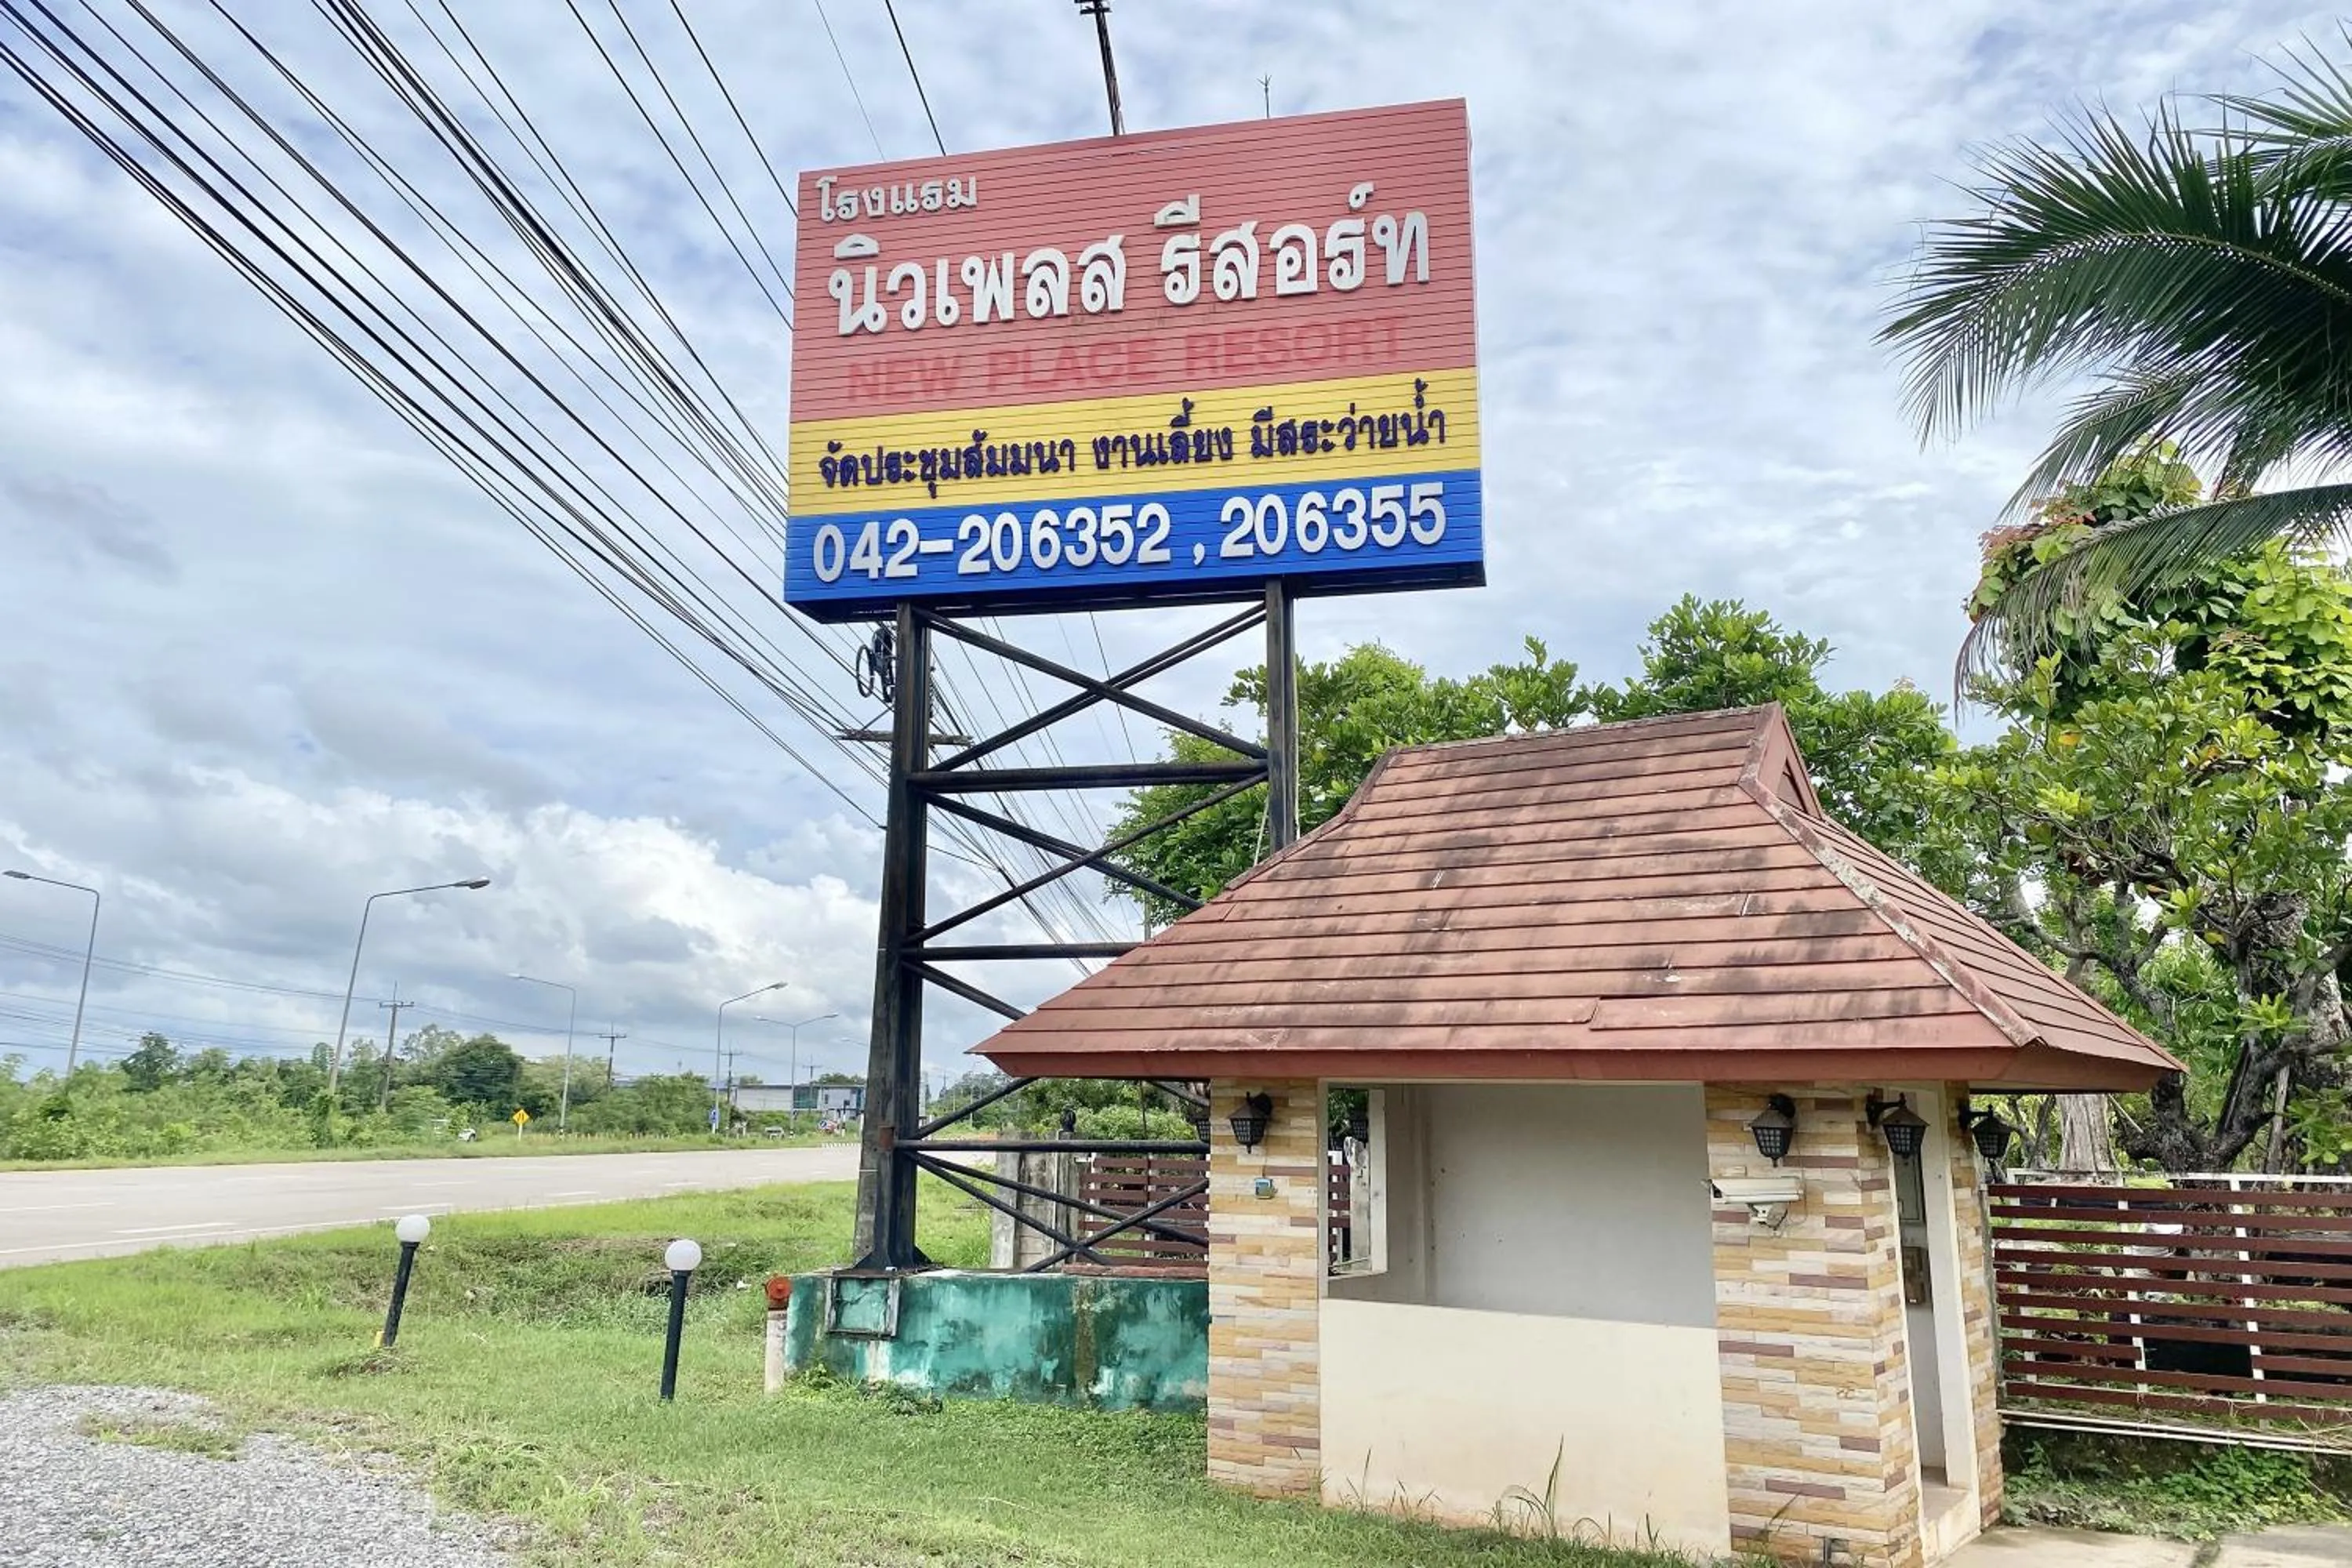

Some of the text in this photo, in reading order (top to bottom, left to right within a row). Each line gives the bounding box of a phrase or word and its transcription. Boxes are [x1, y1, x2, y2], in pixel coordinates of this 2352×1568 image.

[815, 175, 978, 223] โรงแรม
[828, 181, 1430, 336] นิวเพลส รีสอร์ท
[848, 315, 1409, 402] NEW PLACE RESORT
[818, 377, 1446, 499] จัดประชุมสัมมนา งานเลี้ยง มีสระว่ายน้ำ
[812, 502, 1171, 583] 042-206352
